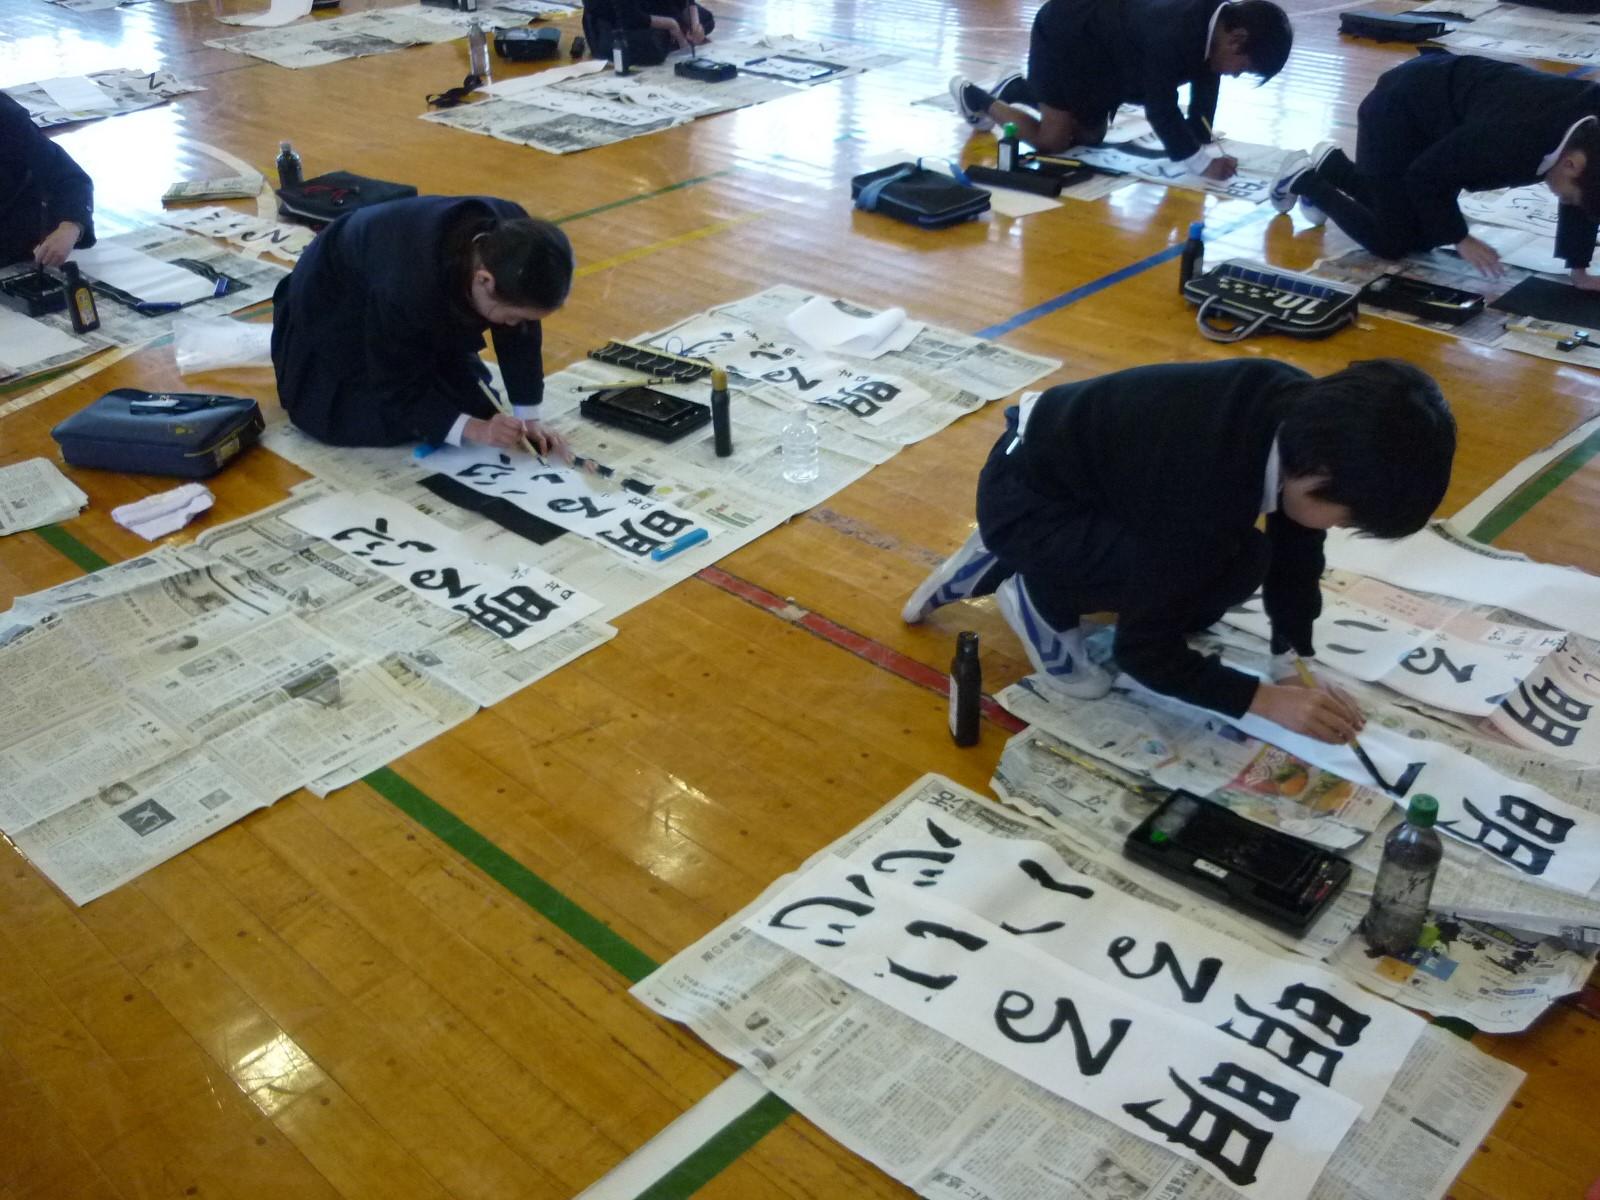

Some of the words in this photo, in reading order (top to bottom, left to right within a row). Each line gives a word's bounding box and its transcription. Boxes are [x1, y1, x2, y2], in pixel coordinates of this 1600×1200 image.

[332, 518, 559, 639] 明るい心
[768, 874, 1300, 1186] 明るい心
[872, 818, 1371, 1087] 明るい心
